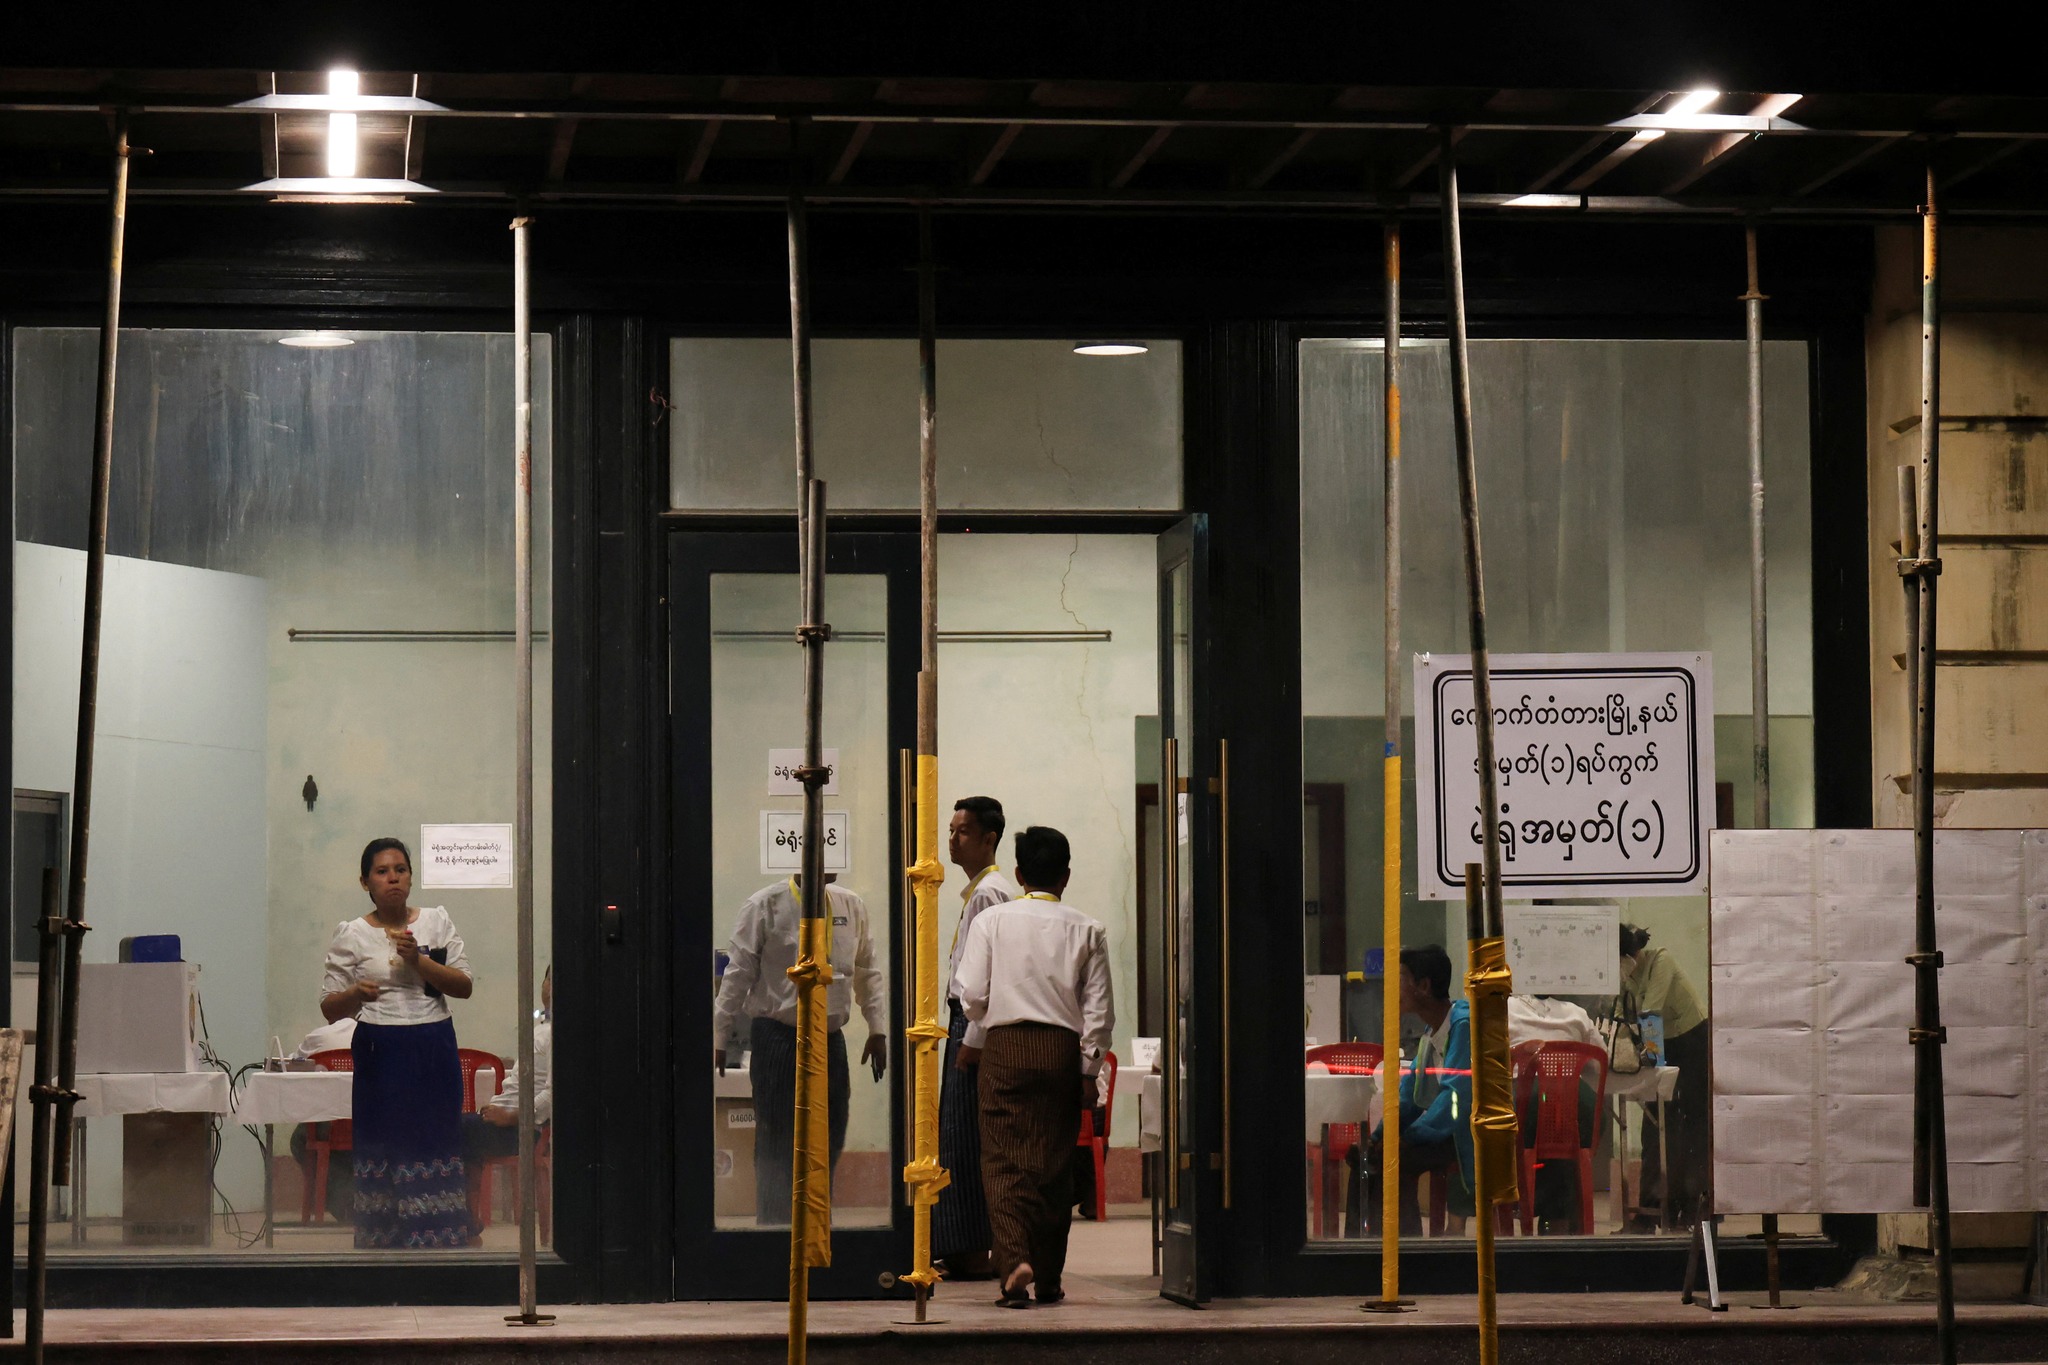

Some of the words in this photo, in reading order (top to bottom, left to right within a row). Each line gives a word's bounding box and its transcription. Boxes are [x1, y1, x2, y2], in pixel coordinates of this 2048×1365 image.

[1451, 693, 1678, 736] ောက်တံတားမြို့နယ်
[1473, 742, 1659, 786] မှတ်(၁)ရပ်ကွက်
[730, 1113, 755, 1123] 04600
